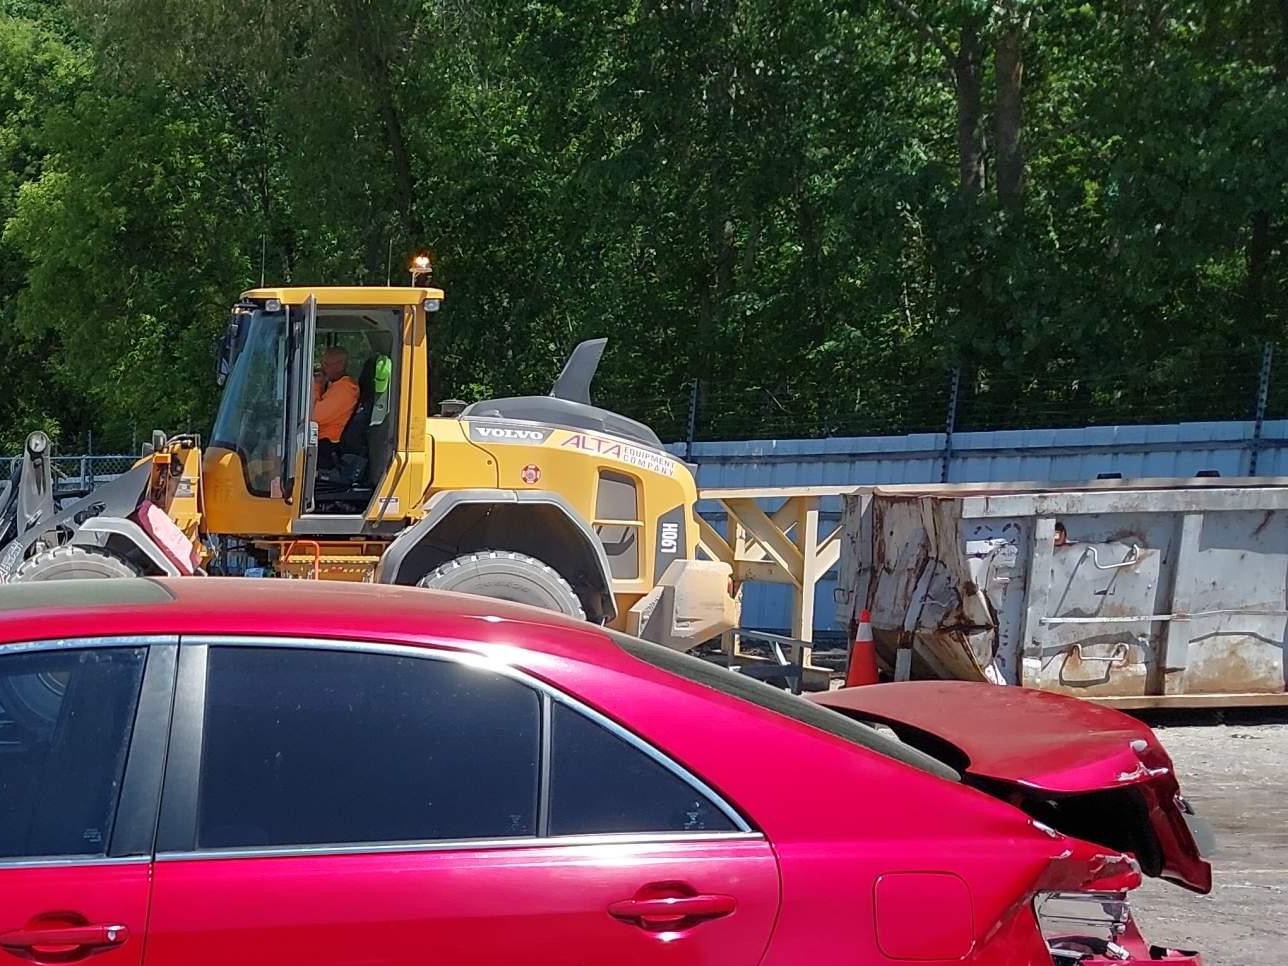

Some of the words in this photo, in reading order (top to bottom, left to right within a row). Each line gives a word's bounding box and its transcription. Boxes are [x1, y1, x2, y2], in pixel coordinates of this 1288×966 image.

[475, 427, 544, 440] VOLVO
[561, 434, 621, 459] ALTA
[624, 446, 675, 469] EQUIPMENT
[623, 454, 674, 476] COMPANY
[661, 523, 678, 553] L90H
